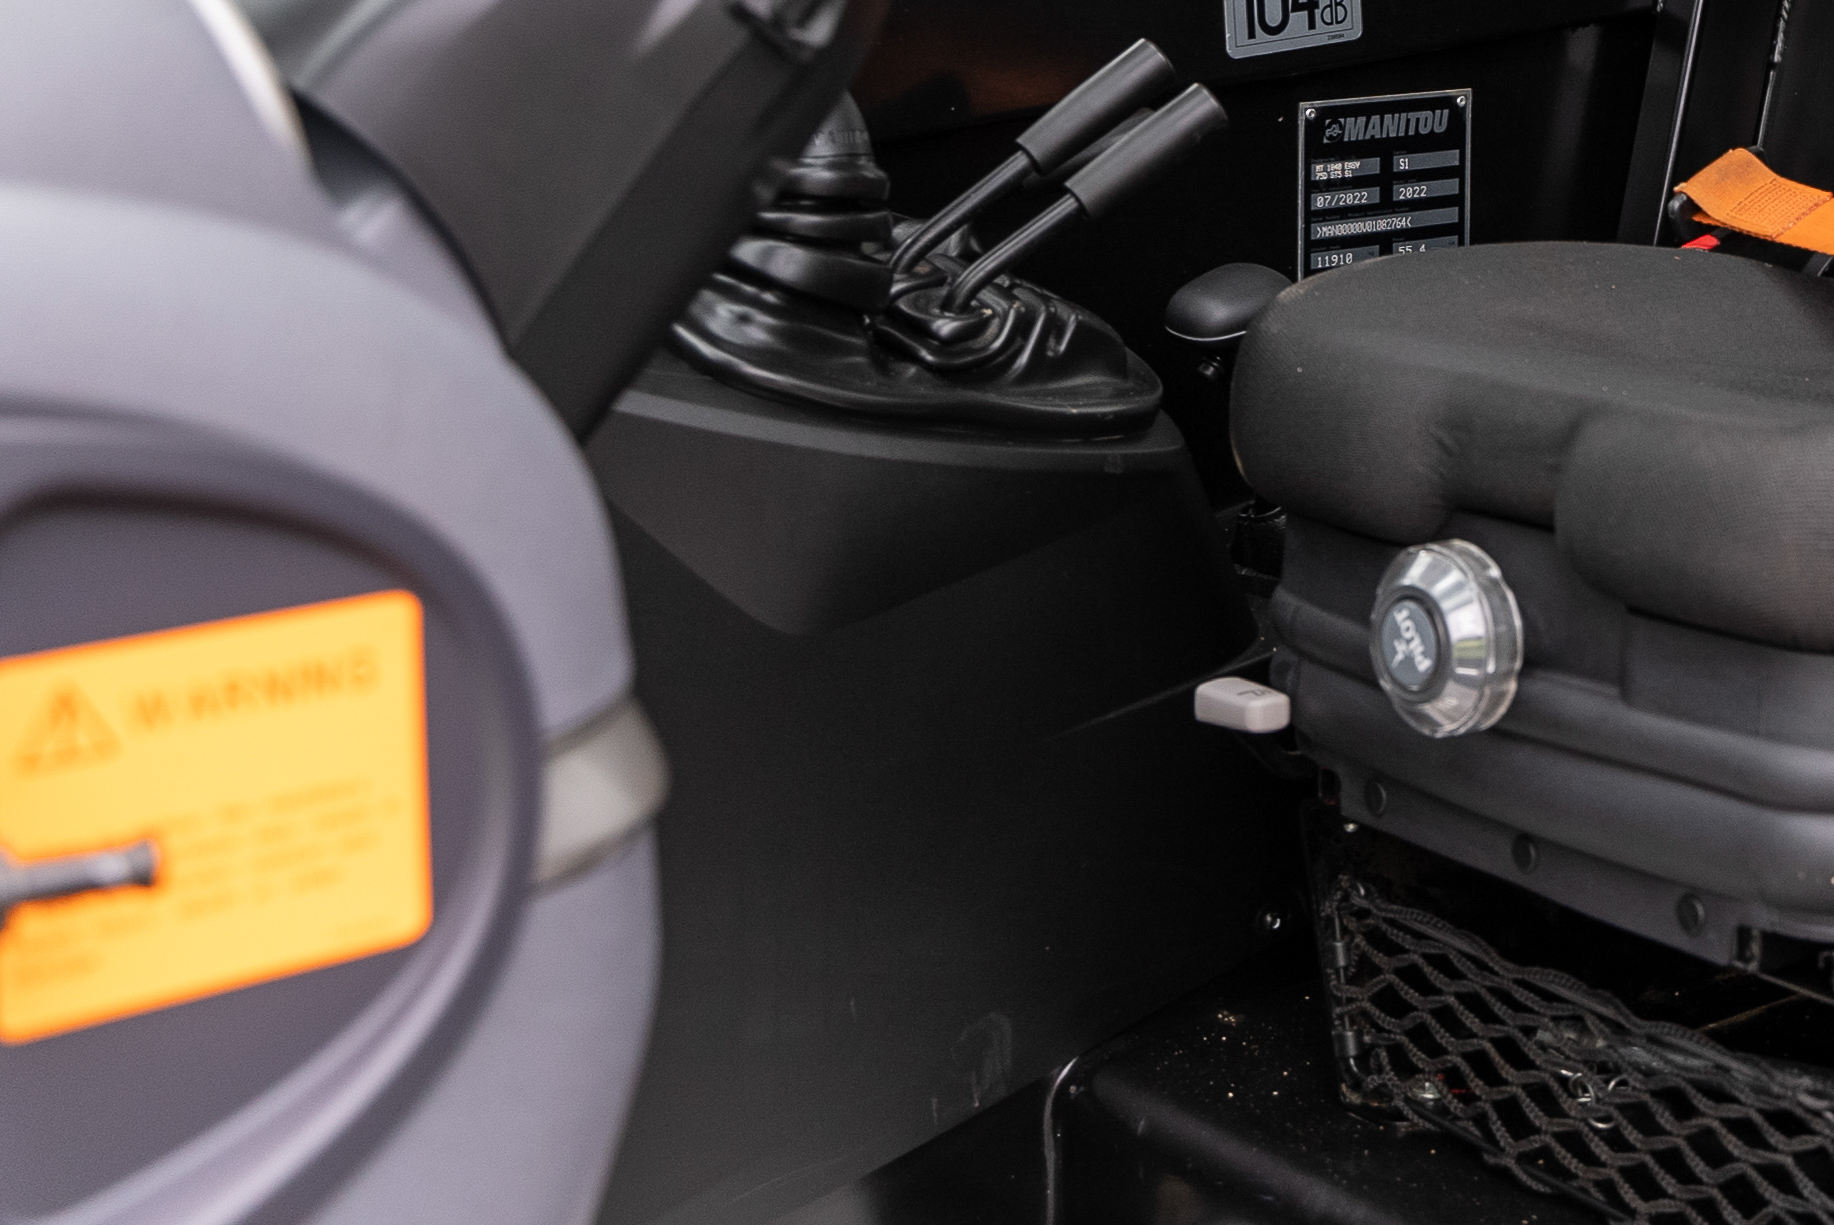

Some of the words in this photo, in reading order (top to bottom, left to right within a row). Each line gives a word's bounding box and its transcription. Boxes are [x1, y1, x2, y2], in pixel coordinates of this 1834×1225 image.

[1343, 109, 1450, 142] MANITOU
[1399, 158, 1409, 170] S1
[1316, 191, 1368, 208] 07/2022
[1399, 185, 1427, 199] 2022
[1316, 252, 1353, 268] 11910
[1393, 608, 1434, 673] PILOT
